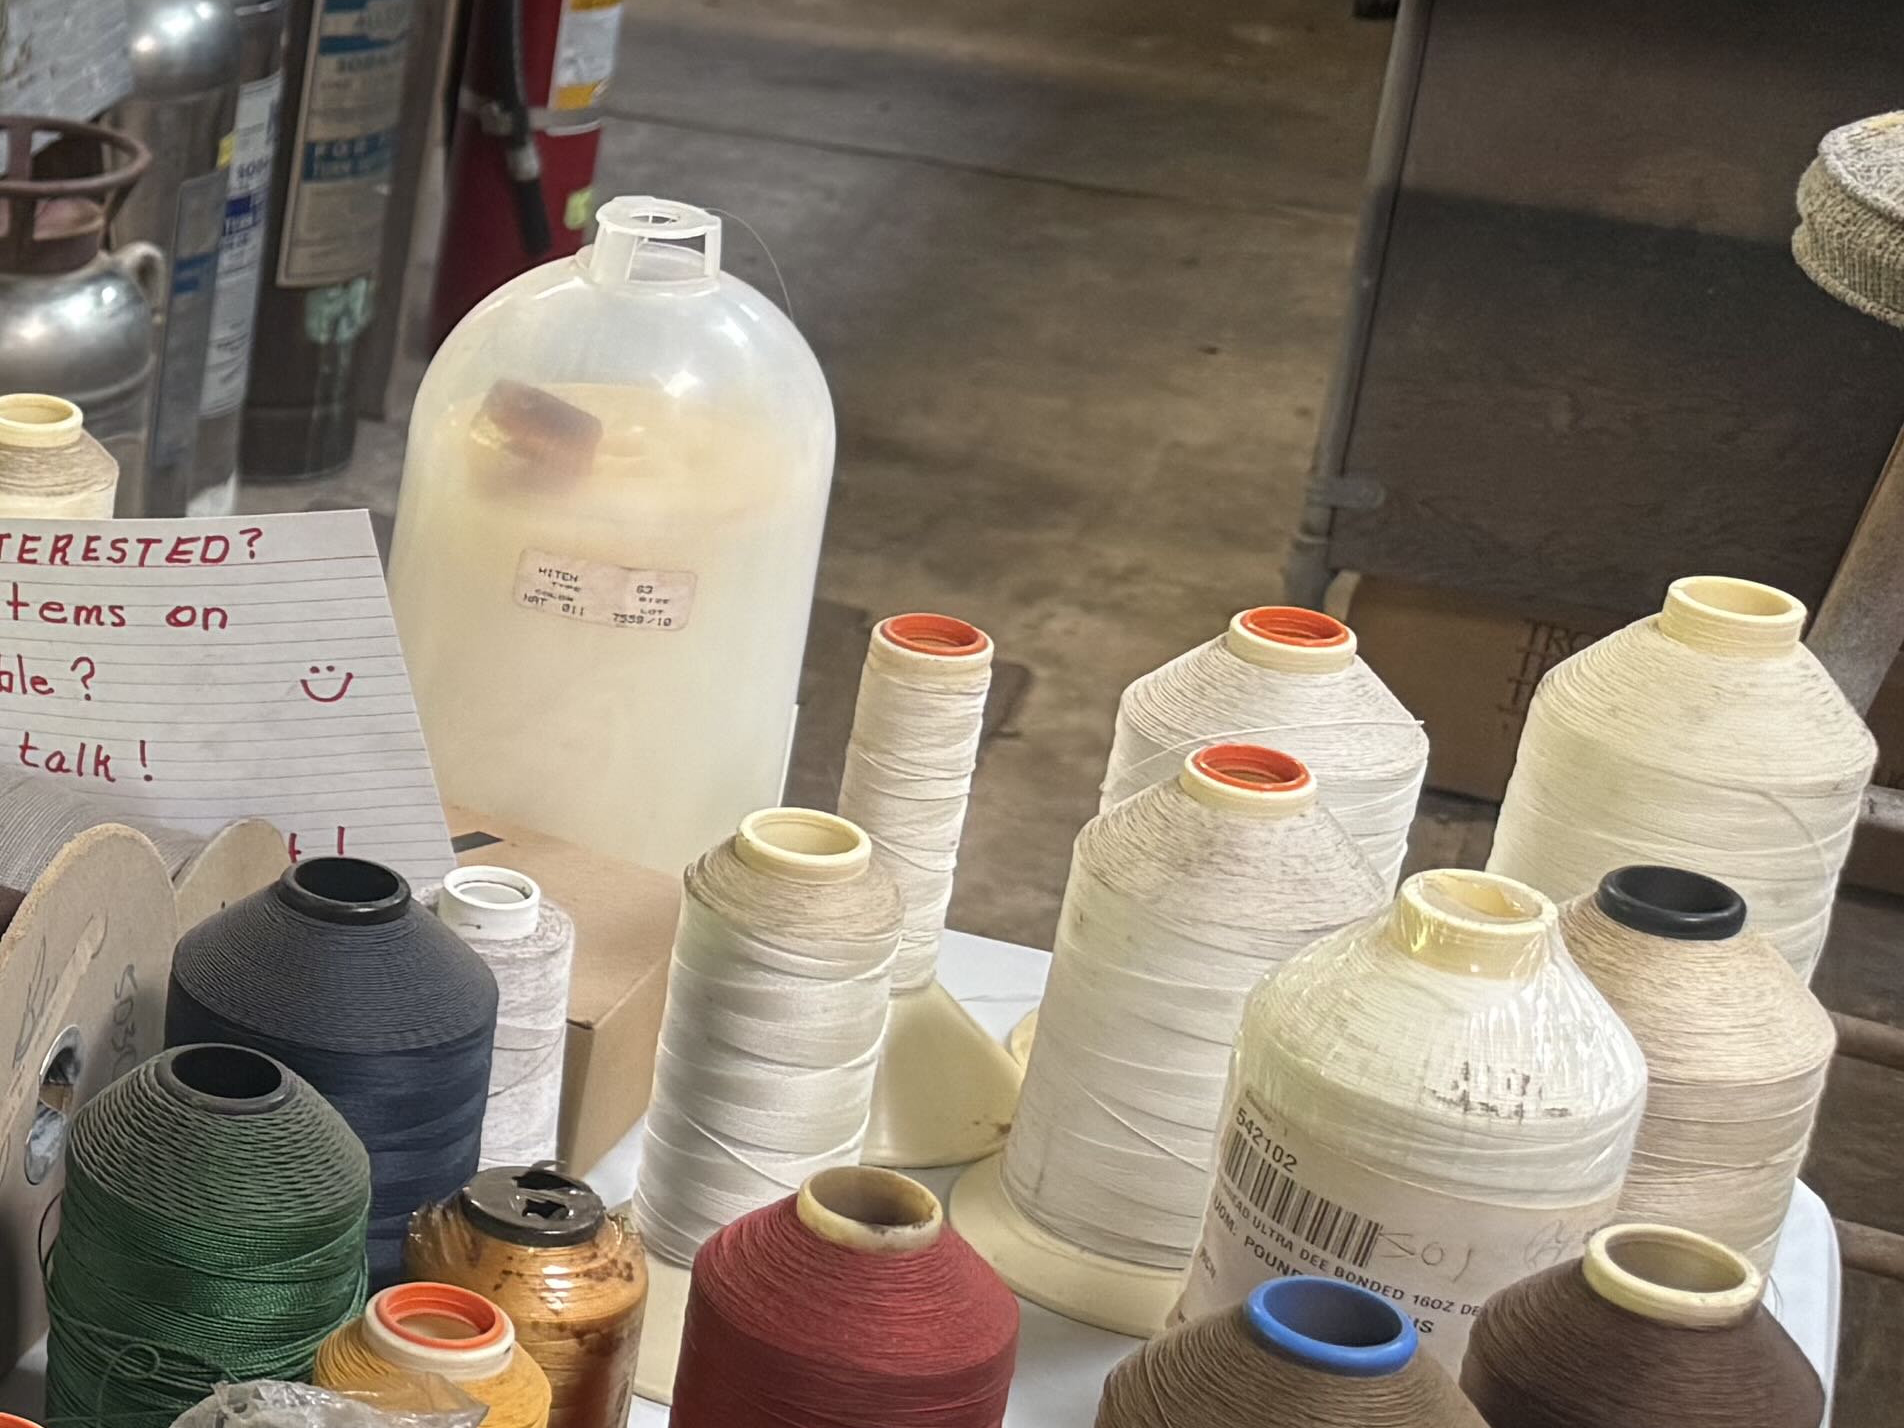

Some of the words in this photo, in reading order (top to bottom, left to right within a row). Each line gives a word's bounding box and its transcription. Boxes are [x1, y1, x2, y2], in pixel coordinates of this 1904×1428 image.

[164, 603, 230, 632] on
[1235, 1106, 1298, 1173] 542102
[1252, 1215, 1294, 1253] ULTRA
[1299, 1248, 1328, 1272] DEE
[1334, 1265, 1405, 1301] BONDED
